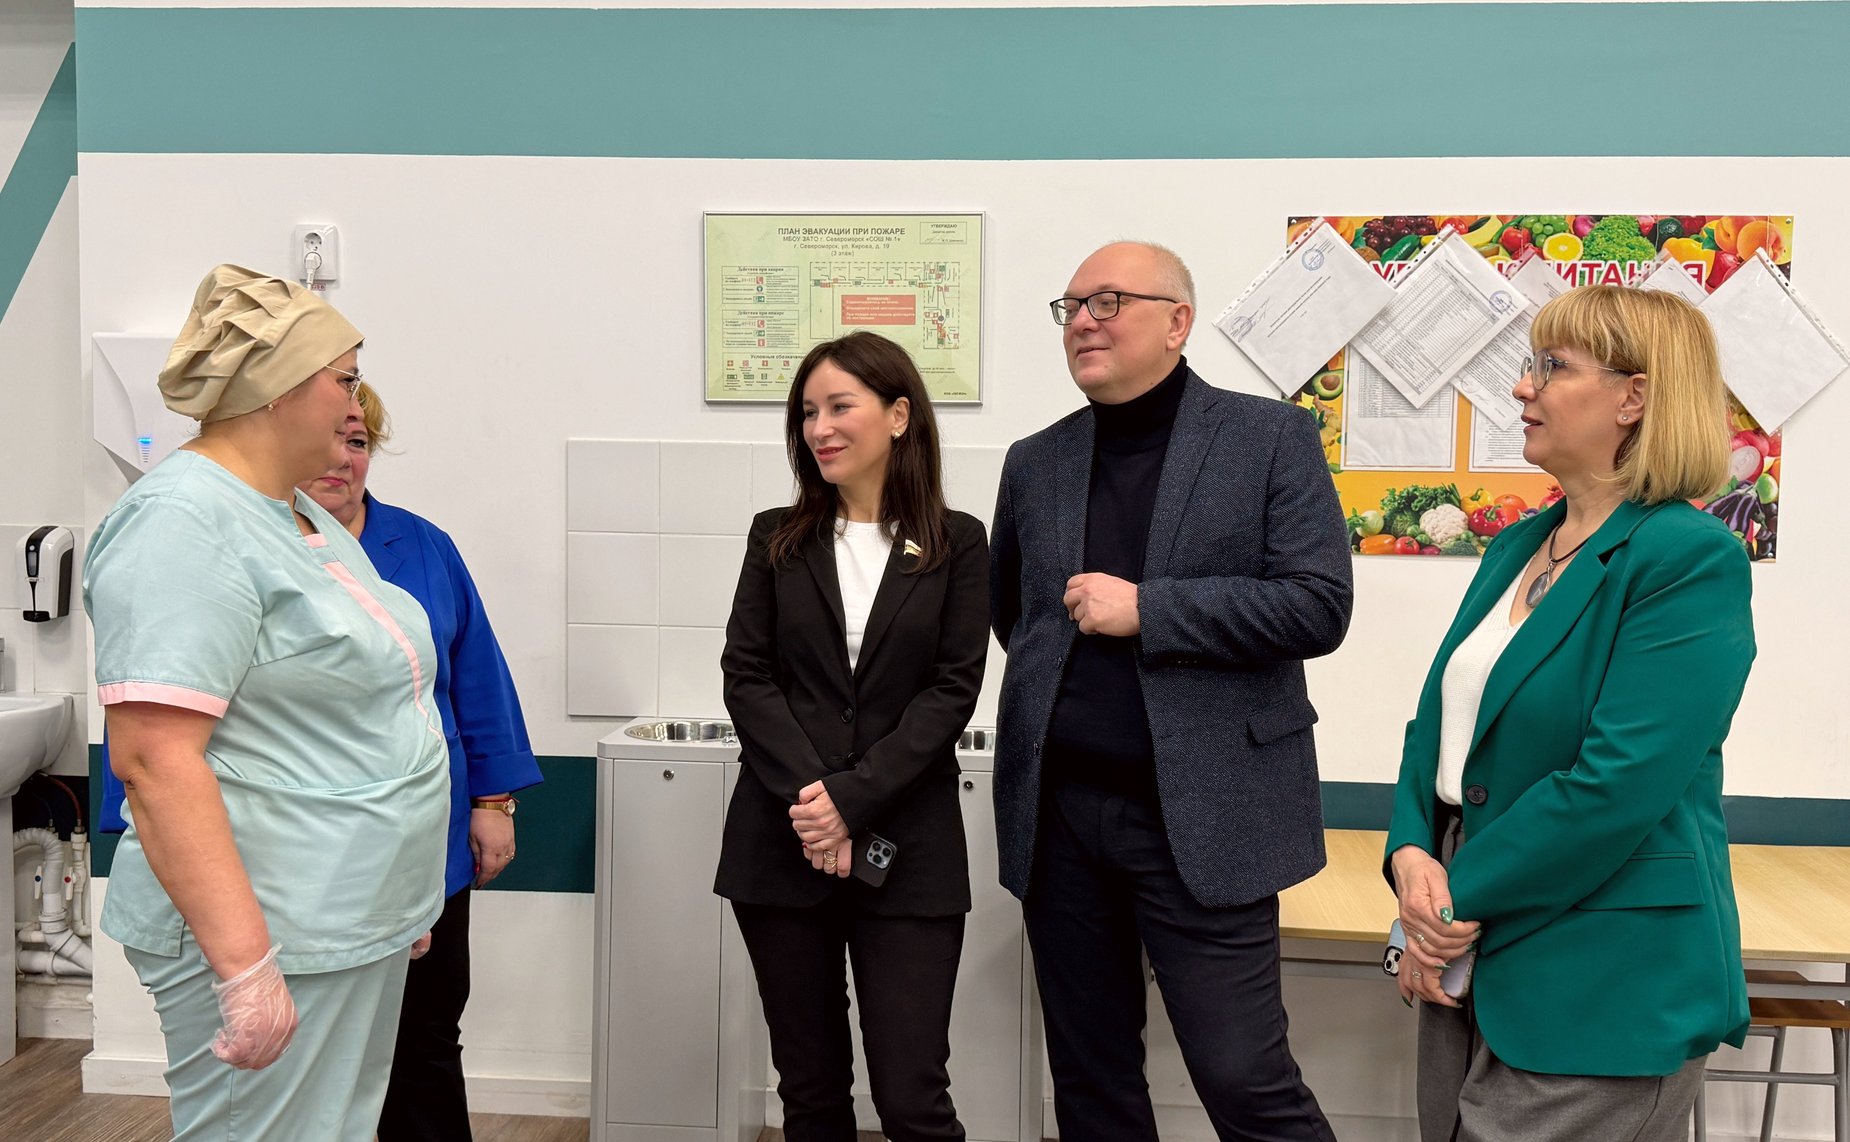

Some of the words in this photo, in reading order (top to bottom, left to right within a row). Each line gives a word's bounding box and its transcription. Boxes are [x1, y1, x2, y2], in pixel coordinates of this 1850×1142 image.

[778, 227, 801, 235] ПЛАН
[802, 227, 851, 236] ЭВАКУАЦИИ
[853, 227, 869, 235] ПРИ
[871, 227, 906, 235] ПОЖАРЕ
